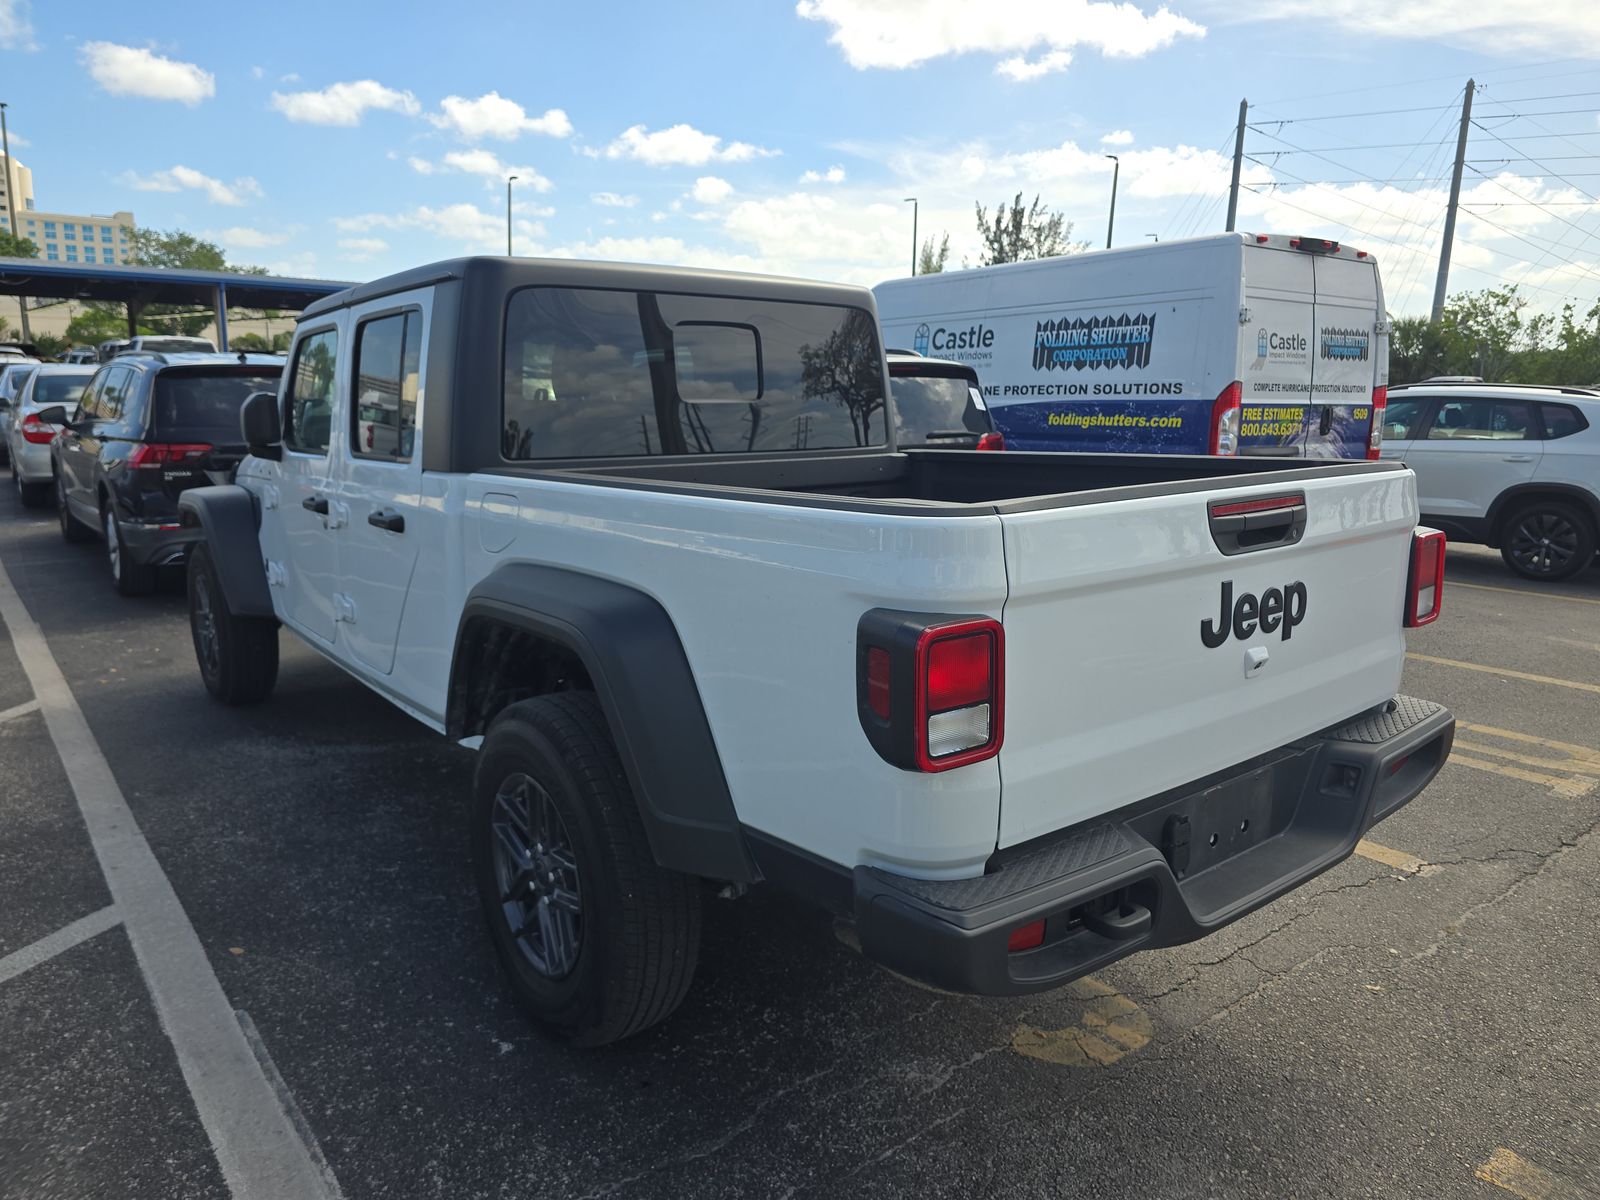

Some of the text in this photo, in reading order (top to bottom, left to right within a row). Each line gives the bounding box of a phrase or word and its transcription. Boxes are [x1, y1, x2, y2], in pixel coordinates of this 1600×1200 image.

[932, 324, 994, 350] Castle
[1036, 325, 1150, 348] FOLDING SHUTTER
[1269, 332, 1306, 351] Castle
[957, 351, 992, 361] Windows
[1053, 347, 1128, 362] CORPORATION
[1004, 384, 1088, 396] PROTECTION
[1093, 382, 1183, 395] SOLUTIONS
[1254, 383, 1367, 393] COMPLETE HURRICANE PROTECTION SOLUTIONS
[1048, 413, 1182, 429] foldingshutters.com
[1242, 407, 1304, 421] FREE ESTIMATES
[1353, 408, 1368, 420] 1509
[1201, 580, 1307, 649] Jeep
